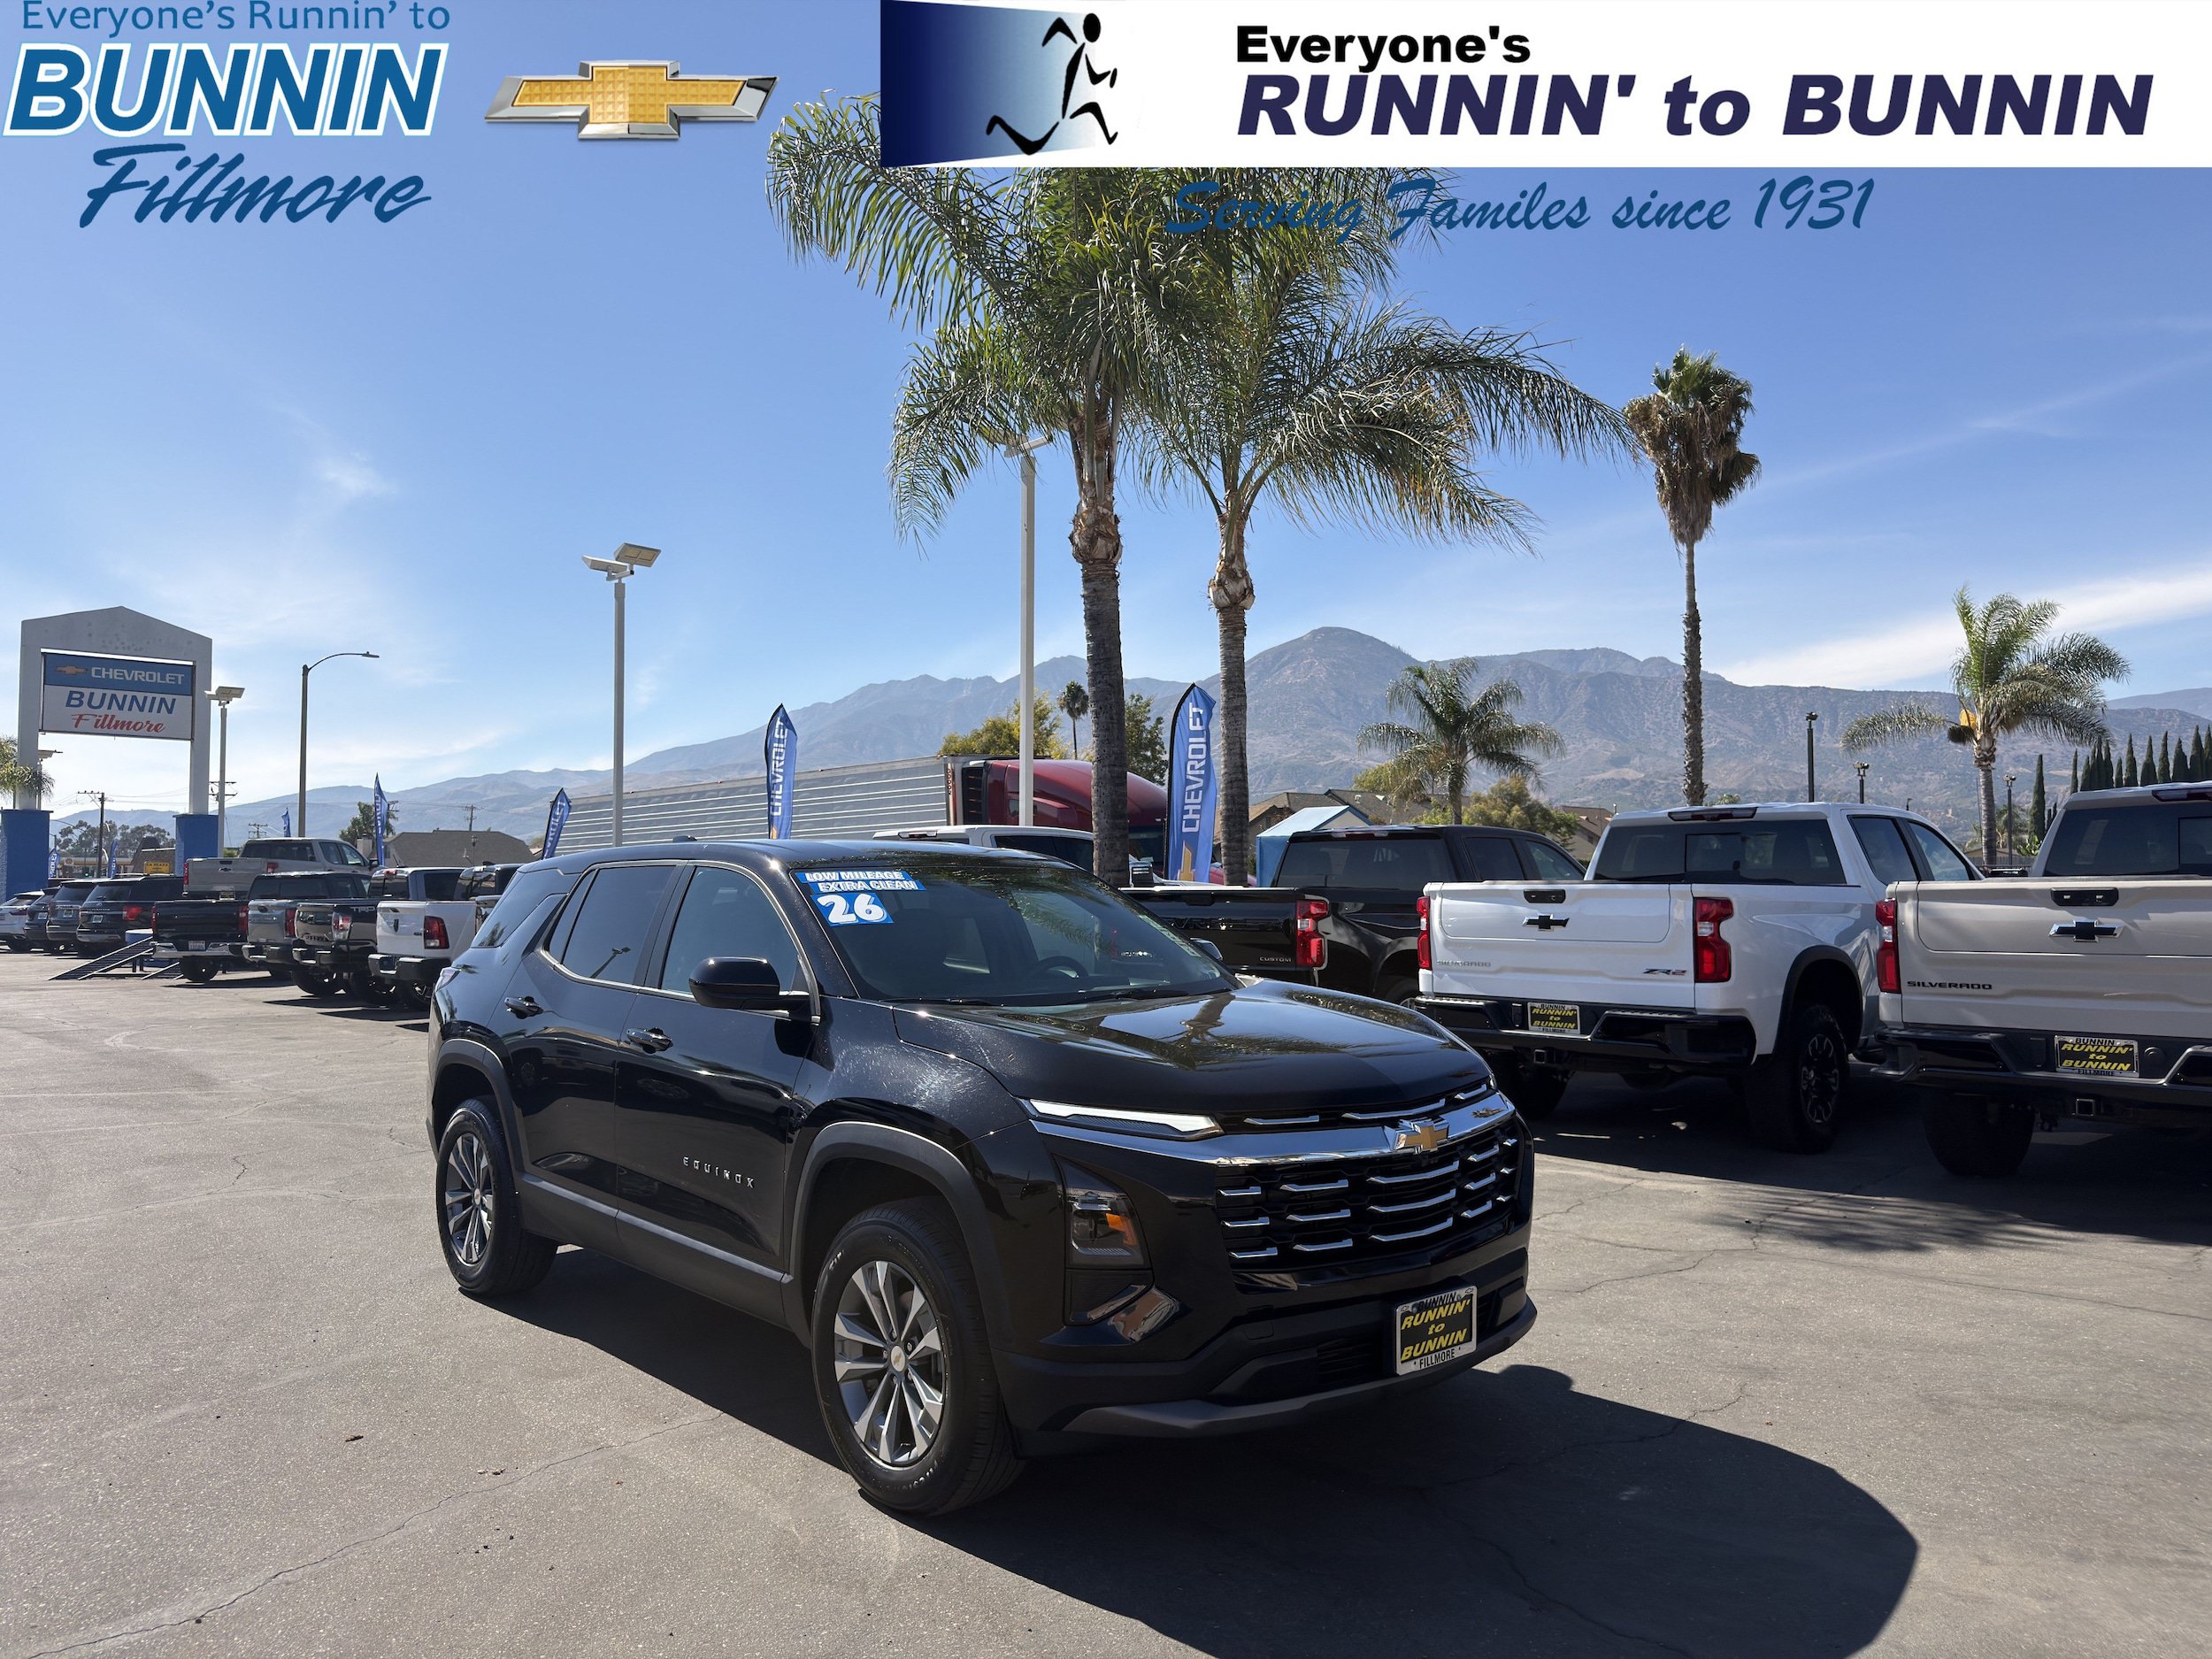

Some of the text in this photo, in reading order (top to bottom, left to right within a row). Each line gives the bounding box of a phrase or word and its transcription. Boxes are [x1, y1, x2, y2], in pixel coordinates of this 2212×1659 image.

[91, 666, 185, 685] CHEVROLET
[65, 690, 177, 715] BUNNIN
[71, 713, 166, 733] Fillmore
[770, 717, 788, 816] CHEVROLET
[1181, 702, 1207, 833] CHEVROLET
[804, 871, 905, 881] LOW MILEAGE
[818, 880, 918, 892] EXTRA CLEAN
[817, 894, 887, 923] 26
[1907, 980, 1993, 990] SILVERADO
[1532, 1008, 1577, 1017] RUNNIN'
[1532, 1020, 1576, 1029] BUNNIN
[2061, 1044, 2133, 1054] RUNNIN'
[2062, 1060, 2131, 1071] BUNNIN
[682, 1156, 754, 1189] EQUINOX
[1401, 1299, 1471, 1330] RUNNIN'
[1428, 1323, 1445, 1335] to
[1401, 1328, 1467, 1362] BUNNIN
[1419, 1348, 1455, 1369] FILLMORE
